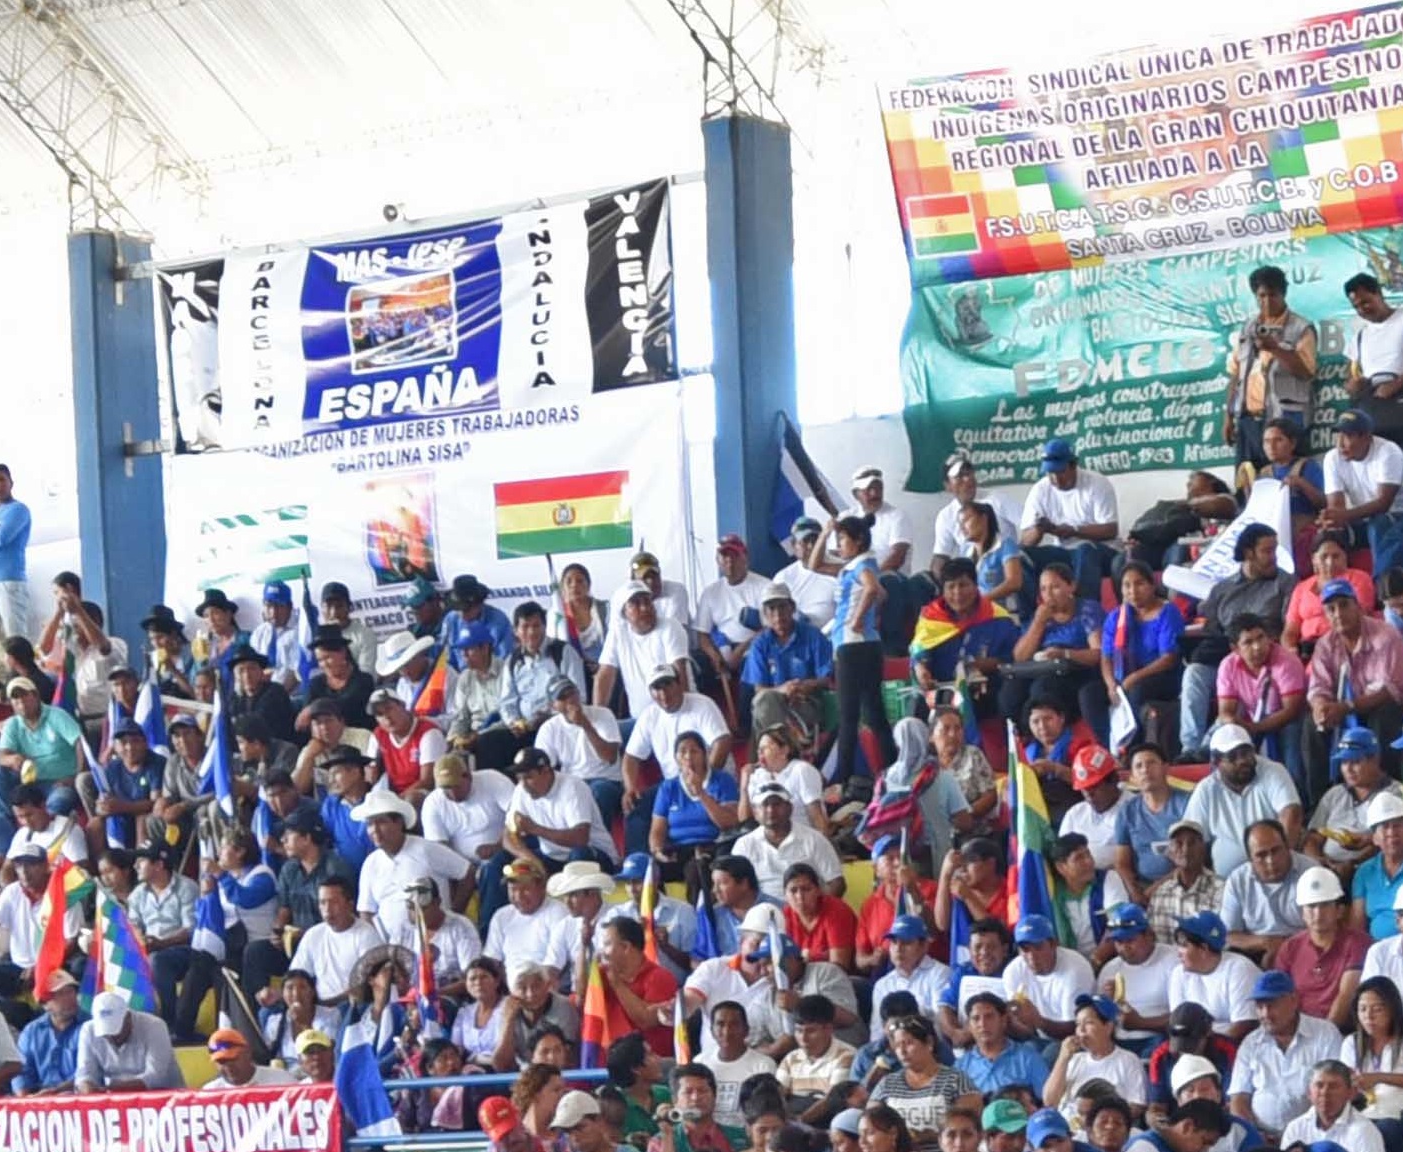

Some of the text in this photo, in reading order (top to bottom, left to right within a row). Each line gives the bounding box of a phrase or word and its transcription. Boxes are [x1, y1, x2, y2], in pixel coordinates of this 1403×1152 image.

[1028, 61, 1132, 95] SINDICAL
[1139, 46, 1214, 78] UNICA
[1222, 39, 1253, 63] DE
[1263, 8, 1403, 56] TRABAJAD
[952, 83, 1403, 172] REGIONAL DE LA GRAN CHIQUITANIA
[1064, 79, 1227, 124] ORIGINARIOS
[1086, 143, 1266, 189] AFILIADA A LA
[1309, 177, 1324, 200] y
[1066, 206, 1328, 259] SANTA CRUZ BOLIVIA
[1161, 238, 1307, 278] CAMPESINAS
[527, 217, 556, 388] NDALUCIA
[613, 190, 649, 378] VALENCIA
[317, 364, 482, 425] ESPAÑA
[349, 428, 369, 447] DE
[373, 417, 446, 446] MUJERES
[452, 405, 581, 434] TRABAJADORAS
